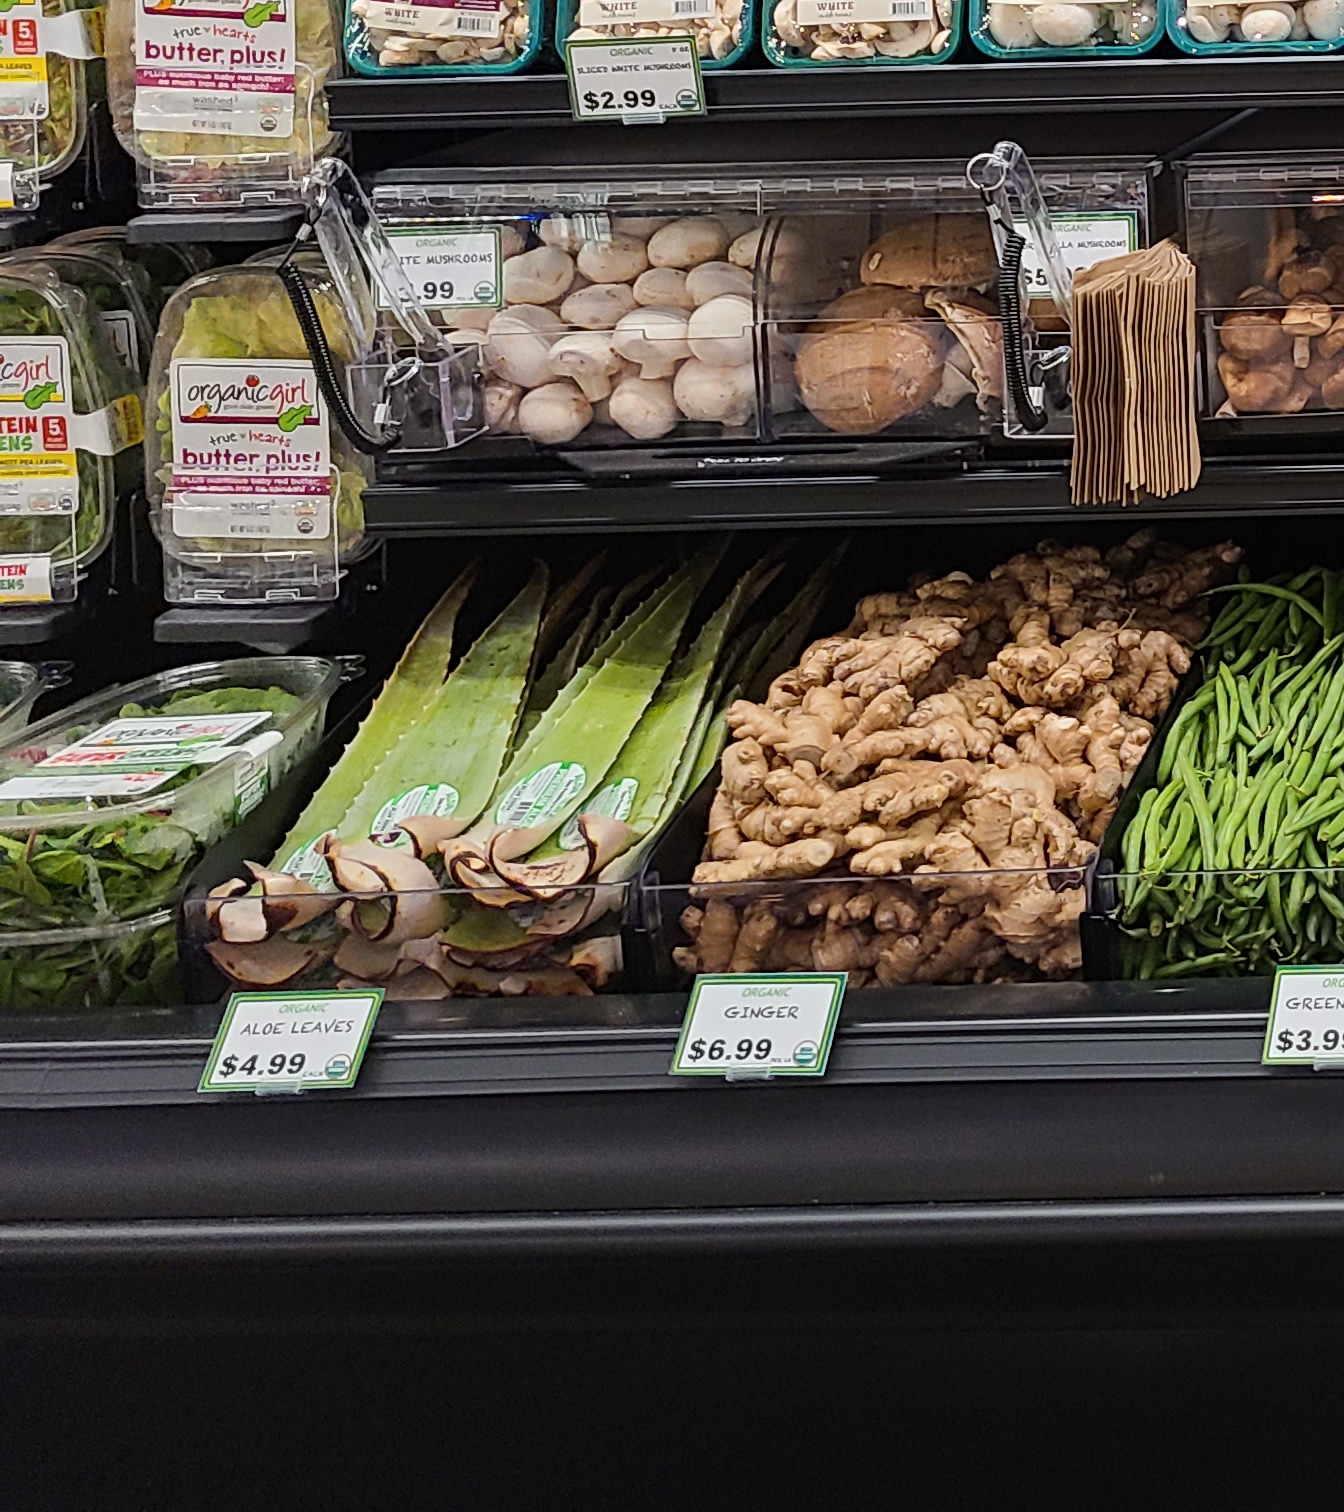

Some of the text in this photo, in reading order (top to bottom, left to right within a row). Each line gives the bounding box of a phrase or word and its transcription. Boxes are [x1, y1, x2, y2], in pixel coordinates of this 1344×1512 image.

[229, 46, 286, 67] plus!
[583, 89, 656, 112] $2.99
[724, 1006, 799, 1020] GINGER
[240, 1019, 354, 1036] ALOE LEAVES
[687, 1038, 772, 1062] $6.99
[218, 1053, 306, 1078] $4.99
